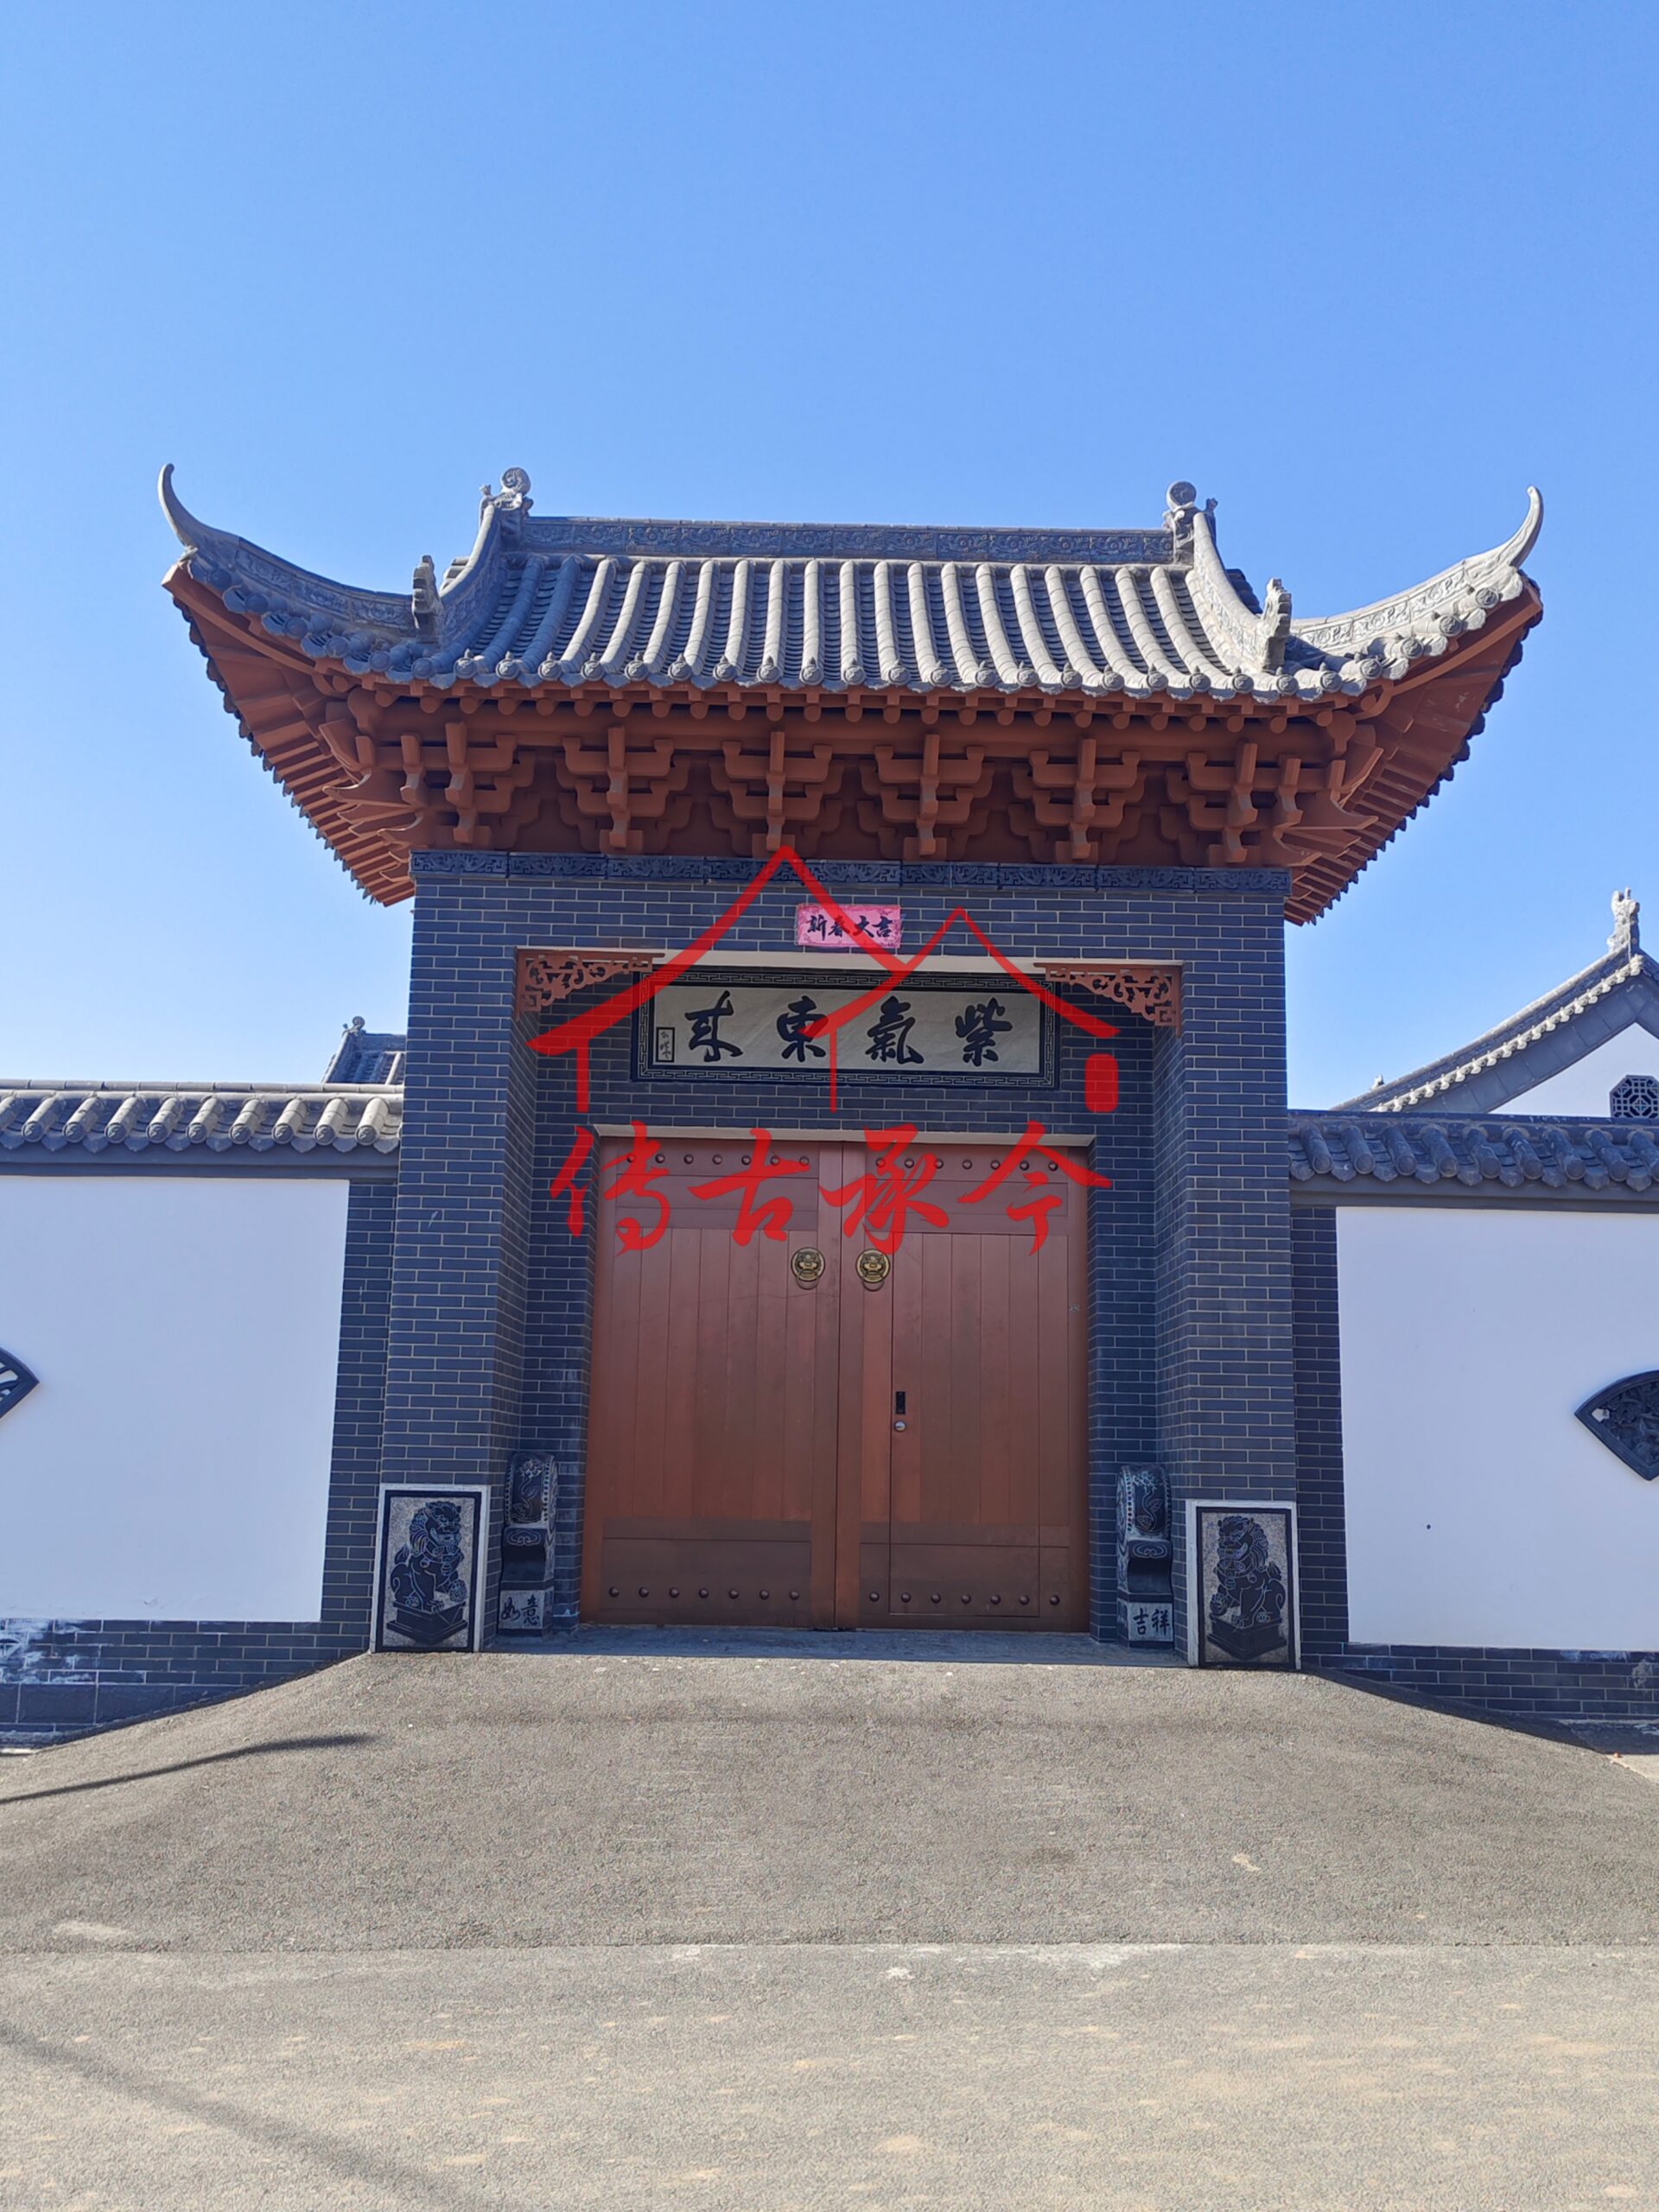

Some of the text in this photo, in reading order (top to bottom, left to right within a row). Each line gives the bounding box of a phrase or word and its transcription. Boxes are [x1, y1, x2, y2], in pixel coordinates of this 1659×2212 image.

[806, 914, 893, 941] 新春大吉
[501, 1594, 540, 1625] 如意
[1133, 1607, 1171, 1635] 吉祥
